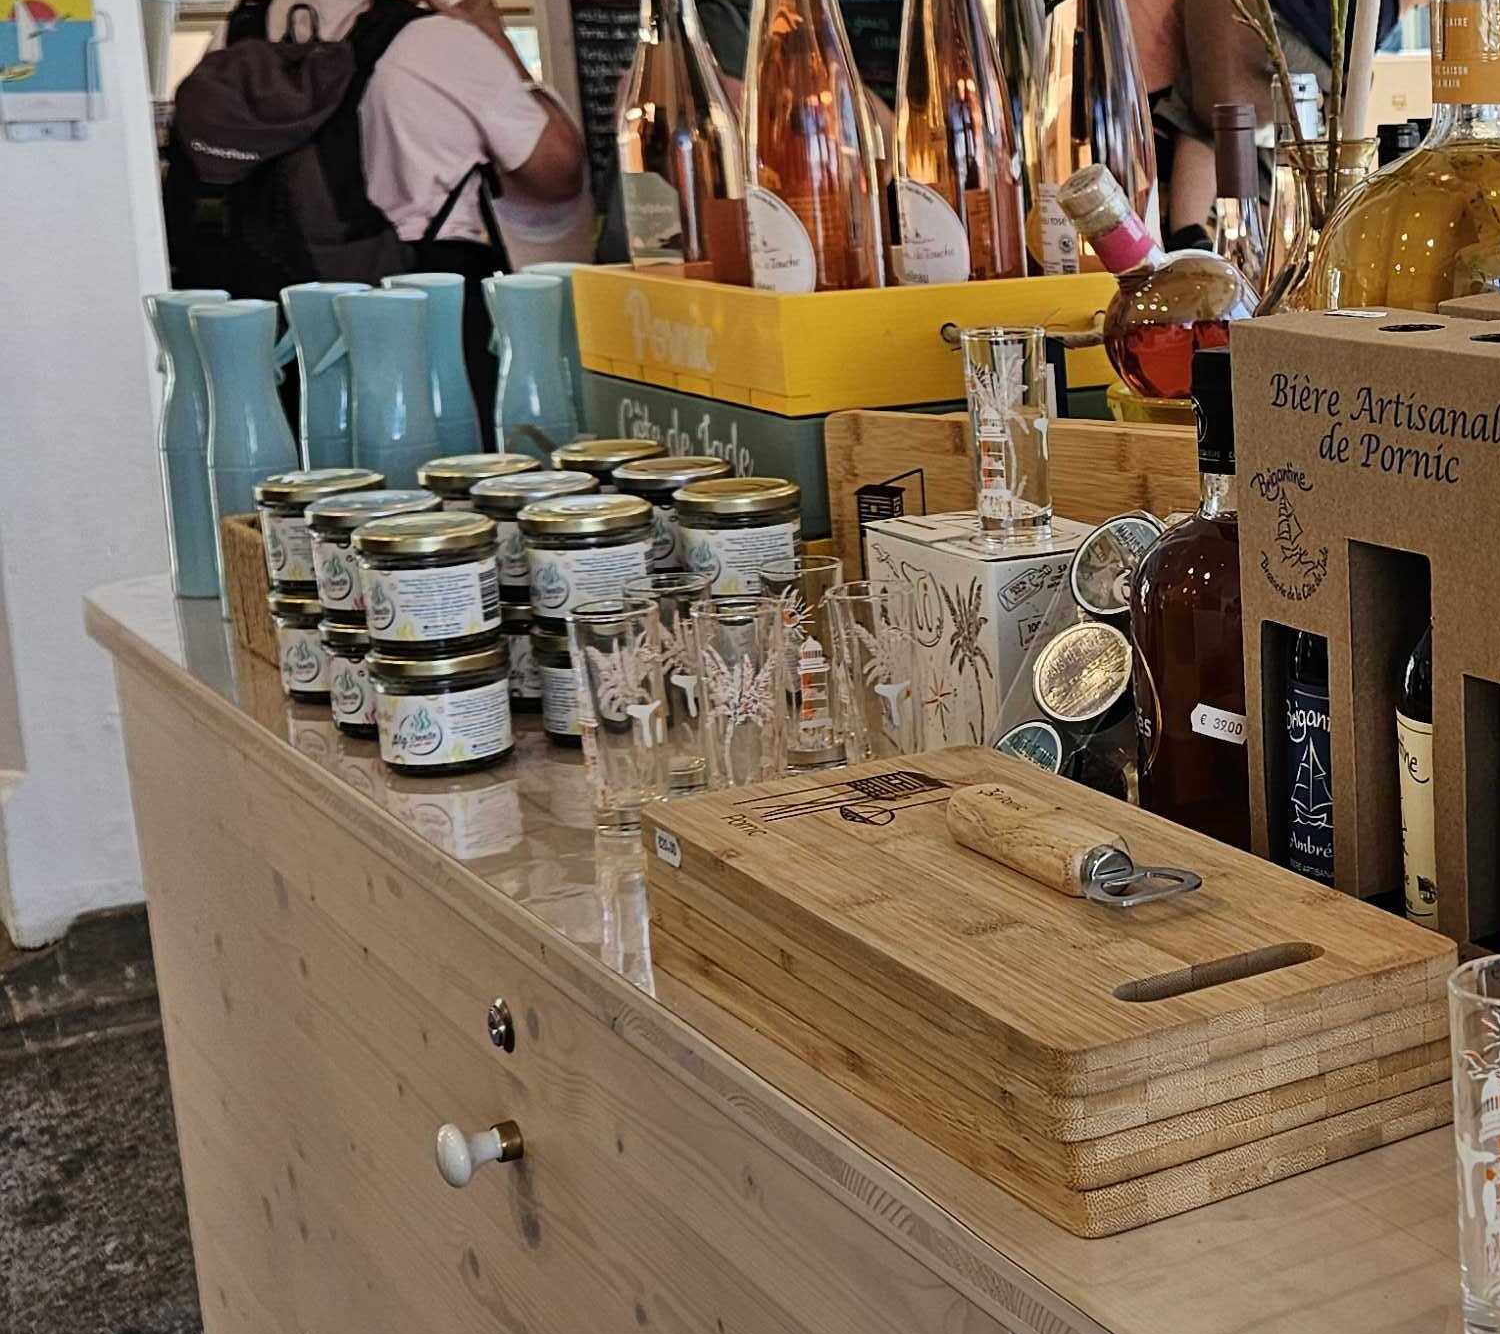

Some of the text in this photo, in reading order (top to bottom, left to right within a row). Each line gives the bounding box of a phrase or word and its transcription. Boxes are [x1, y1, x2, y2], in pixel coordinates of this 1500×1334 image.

[1270, 373, 1341, 417] Bière
[1319, 422, 1460, 484] de Pornic
[1250, 462, 1313, 501] Brigantine
[1200, 713, 1208, 726] €
